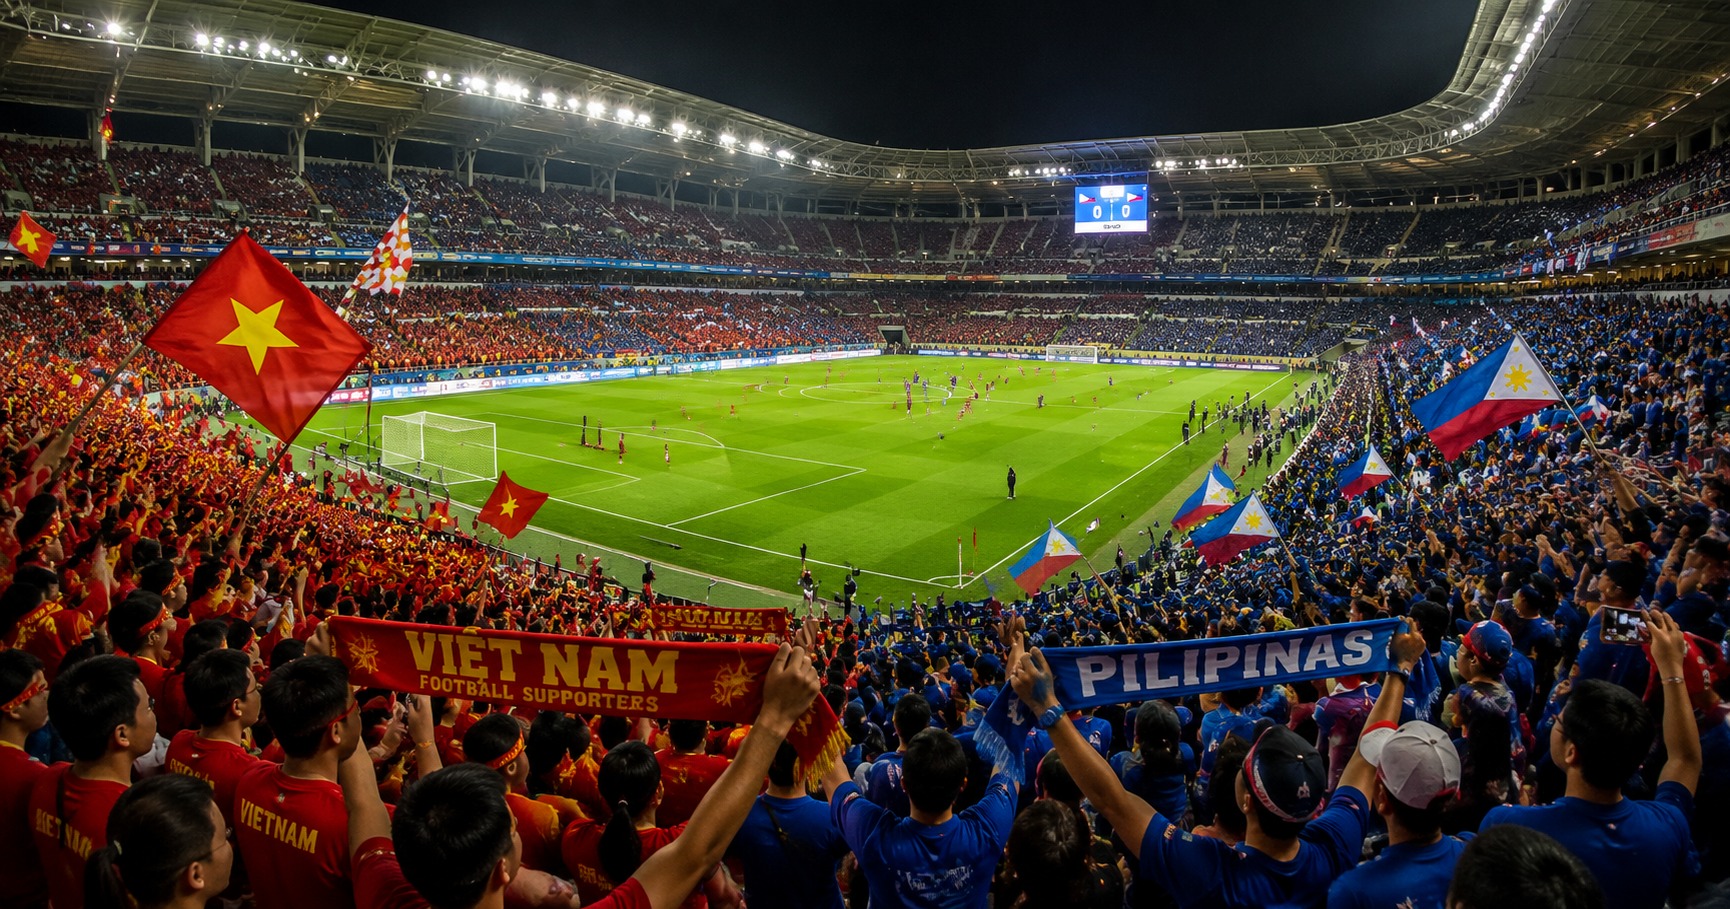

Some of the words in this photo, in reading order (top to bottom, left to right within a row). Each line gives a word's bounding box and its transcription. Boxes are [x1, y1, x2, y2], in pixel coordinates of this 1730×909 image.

[1092, 205, 1102, 219] 0
[1121, 204, 1131, 218] 0
[540, 642, 679, 693] NAM
[1076, 629, 1373, 697] PILIPINAS
[419, 674, 514, 700] FOOTBALL
[522, 686, 659, 712] SUPPORTERS
[240, 797, 319, 854] VIETNAM
